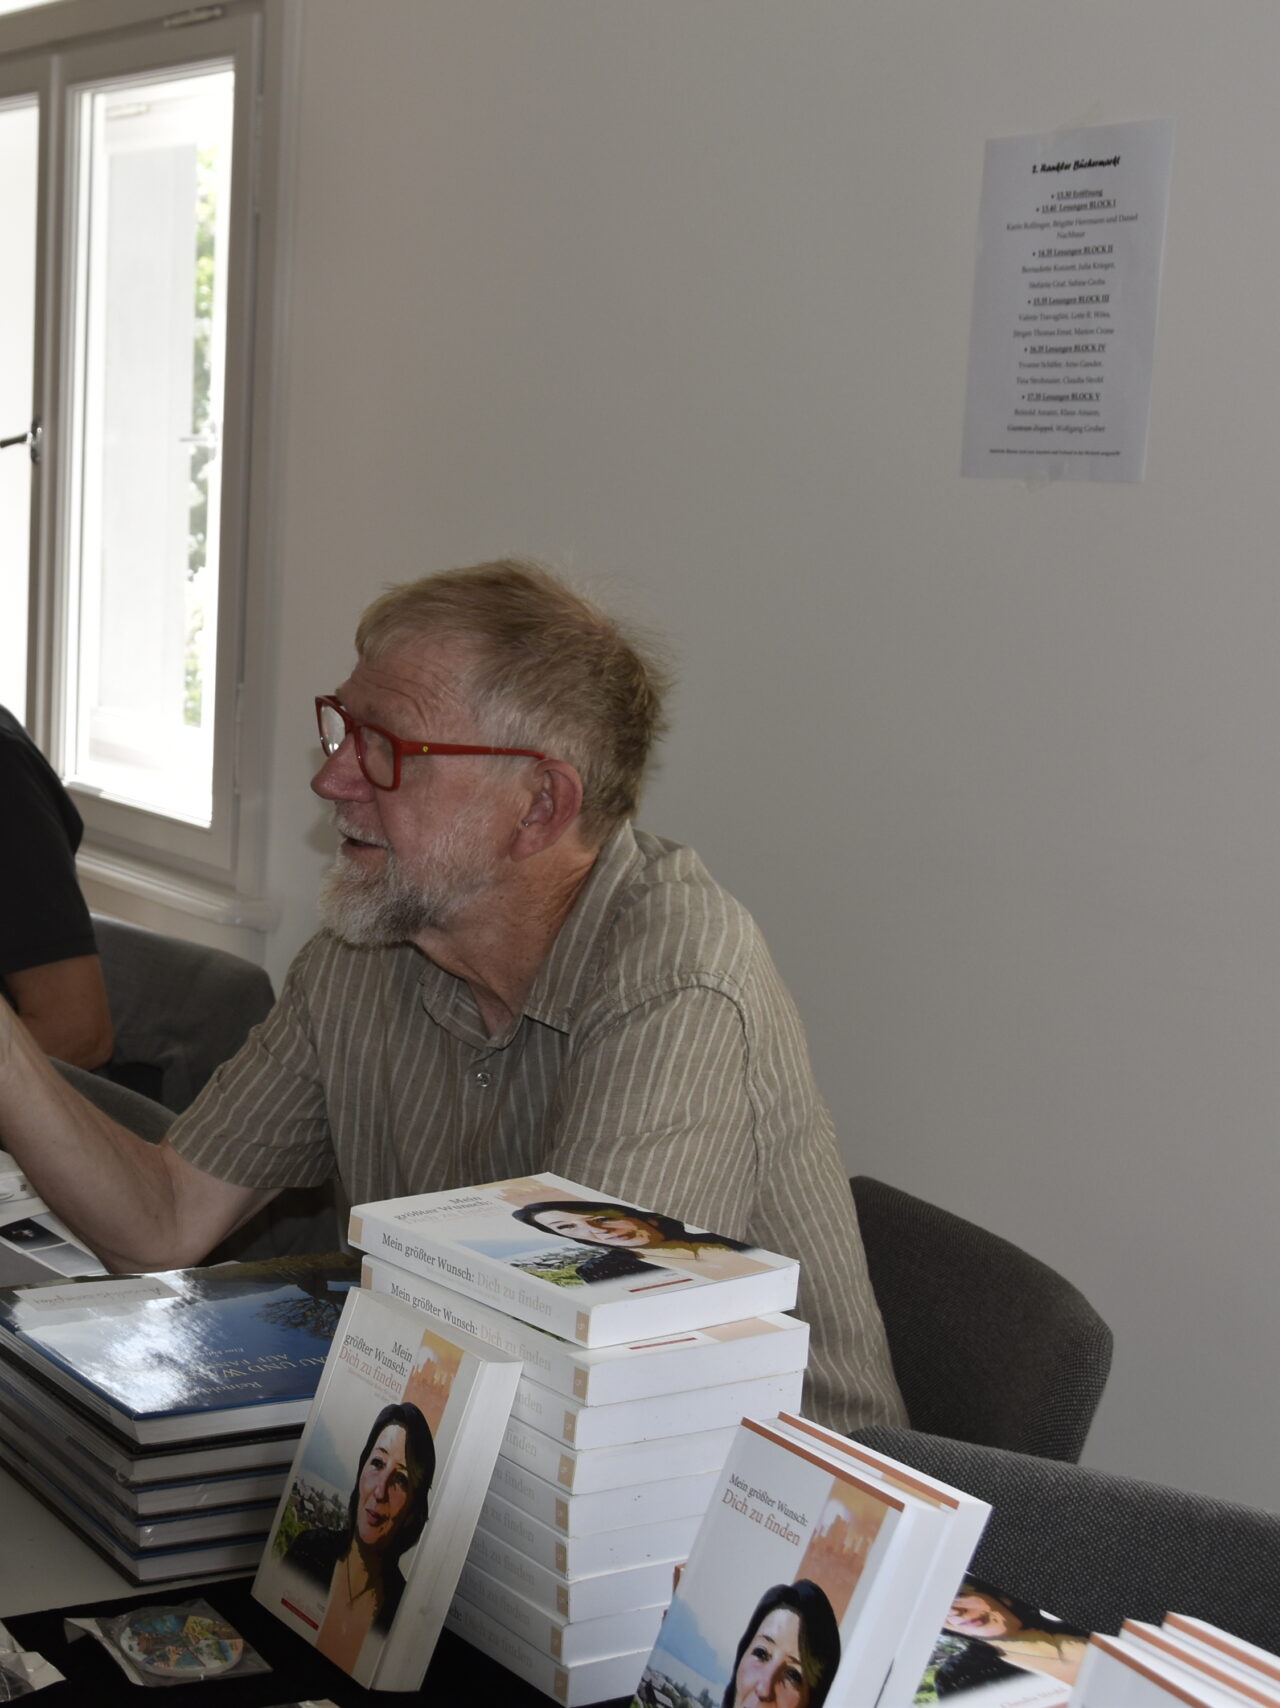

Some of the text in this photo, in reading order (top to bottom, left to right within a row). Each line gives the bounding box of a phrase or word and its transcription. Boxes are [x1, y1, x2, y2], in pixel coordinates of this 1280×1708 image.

[1059, 202, 1088, 213] Lesungen
[1089, 199, 1111, 209] BLOCK
[1054, 246, 1082, 257] Lesungen
[1083, 245, 1106, 255] BLOCK
[1049, 295, 1077, 306] Lesungen
[1078, 294, 1101, 304] BLOCK
[1045, 344, 1072, 354] Lesungen
[1073, 344, 1096, 353] BLOCK
[1042, 392, 1070, 402] Lesungen
[1070, 392, 1094, 401] BLOCK
[382, 1233, 552, 1317] Mein größter Wunsch: Dich zu finden
[391, 1283, 411, 1302] Mein
[412, 1294, 441, 1317] größter
[443, 1307, 478, 1336] Wunsch:
[481, 1325, 502, 1347] Dich
[520, 1344, 552, 1371] finden
[343, 1334, 374, 1357] größter
[375, 1347, 408, 1377] Wunsch:
[392, 1341, 413, 1363] Mein
[247, 1360, 297, 1374] UND
[339, 1346, 359, 1367] Dich
[360, 1362, 372, 1375] zu
[372, 1367, 402, 1394] finden
[729, 1473, 808, 1527] Mein größter Wunsch:
[722, 1488, 801, 1546] Dich zu finden
